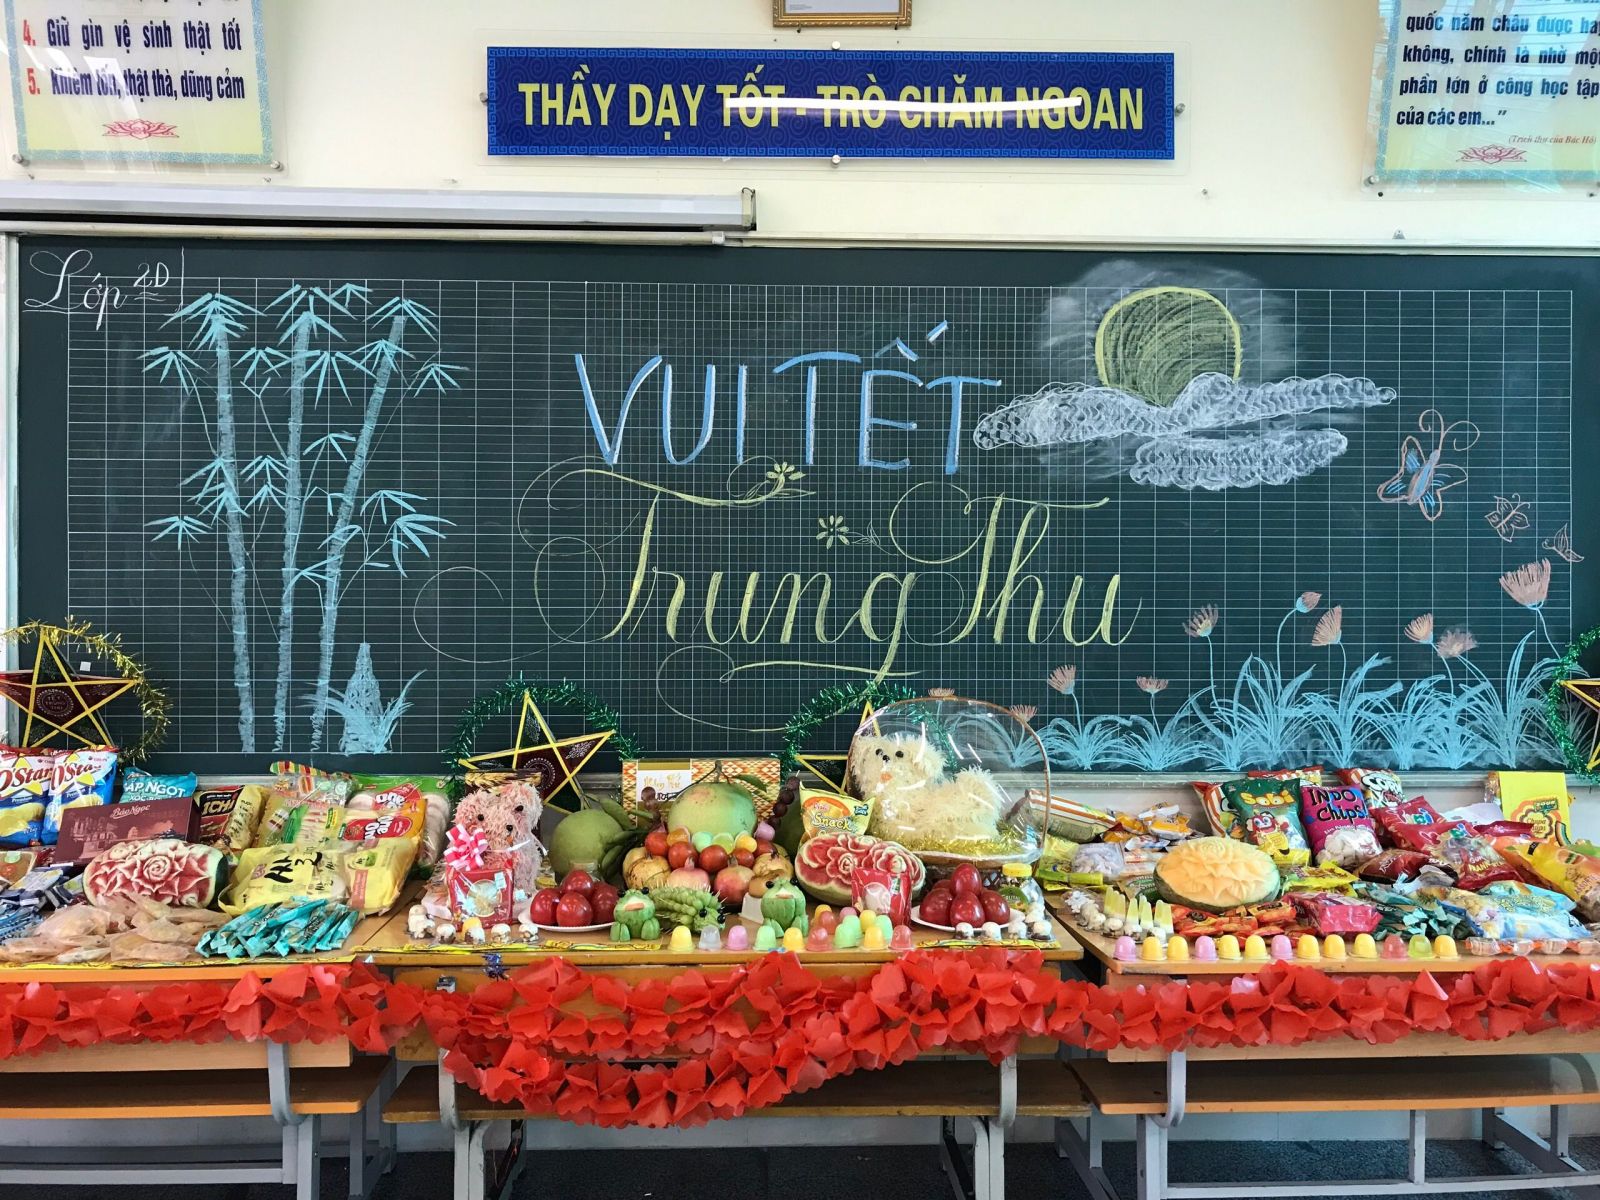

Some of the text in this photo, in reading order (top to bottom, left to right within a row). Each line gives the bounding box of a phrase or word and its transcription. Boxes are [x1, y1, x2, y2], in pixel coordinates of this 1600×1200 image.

[23, 16, 242, 55] 4. Giữ gìn vệ sinh thật tốt
[1406, 11, 1444, 33] quốc
[1451, 14, 1485, 32] năm
[1492, 15, 1530, 32] châu
[1537, 16, 1573, 37] được
[1403, 45, 1454, 65] không,
[1464, 46, 1506, 63] chính
[1516, 46, 1530, 63] là
[1538, 45, 1567, 64] nhờ
[27, 68, 41, 95] 5.
[51, 66, 92, 96] Khiêm
[123, 69, 150, 102] thật
[152, 69, 178, 100] thà,
[181, 70, 213, 101] dũng
[217, 68, 246, 99] cảm
[1400, 73, 1600, 99] phần lớn ở công học tập
[518, 64, 616, 127] THẦY
[628, 84, 705, 141] DẠY
[715, 64, 787, 129] TỐT
[817, 74, 887, 129] TRÒ
[899, 74, 1004, 129] CHĂM
[1016, 86, 1144, 130] NGOAN
[1397, 106, 1424, 125] của
[1427, 108, 1455, 125] các
[1549, 135, 1564, 144] của
[1565, 136, 1580, 144] Bác
[24, 249, 171, 330] Lớp 2D
[574, 320, 1002, 475] VUI TẾT
[890, 481, 1143, 646] Thu
[1308, 789, 1357, 806] INDO
[811, 812, 852, 831] Snack
